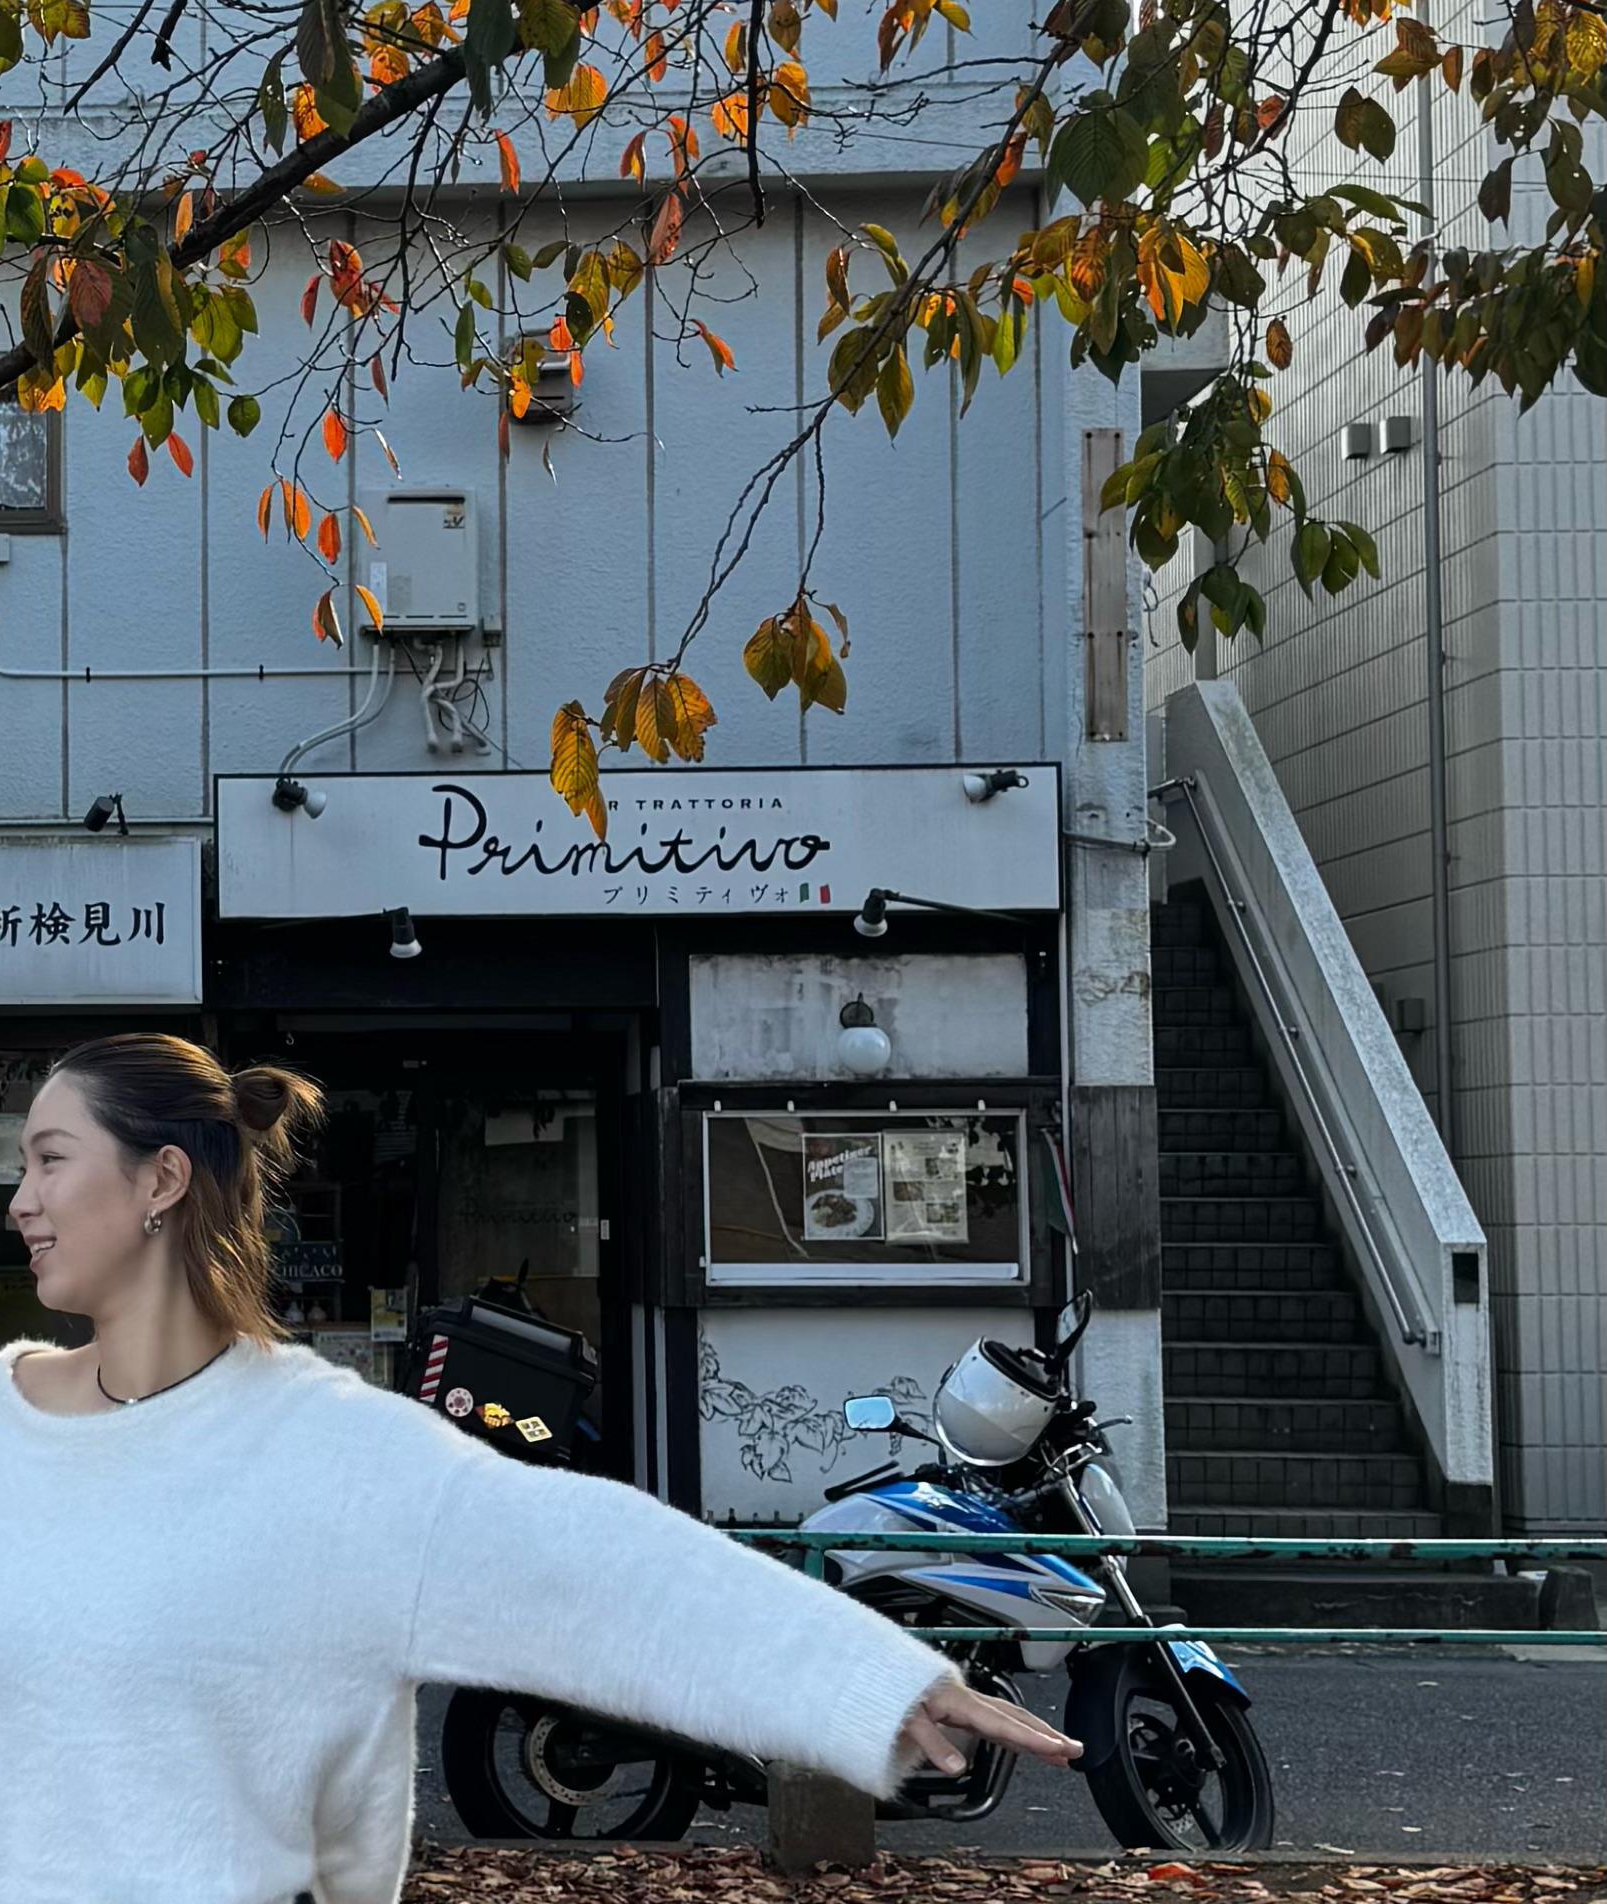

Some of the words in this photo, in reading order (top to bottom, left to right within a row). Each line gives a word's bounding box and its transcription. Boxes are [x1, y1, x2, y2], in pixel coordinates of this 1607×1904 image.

[636, 797, 784, 811] TRATTORIA
[418, 783, 831, 881] Primitivo
[603, 882, 790, 905] プリミティヴォ
